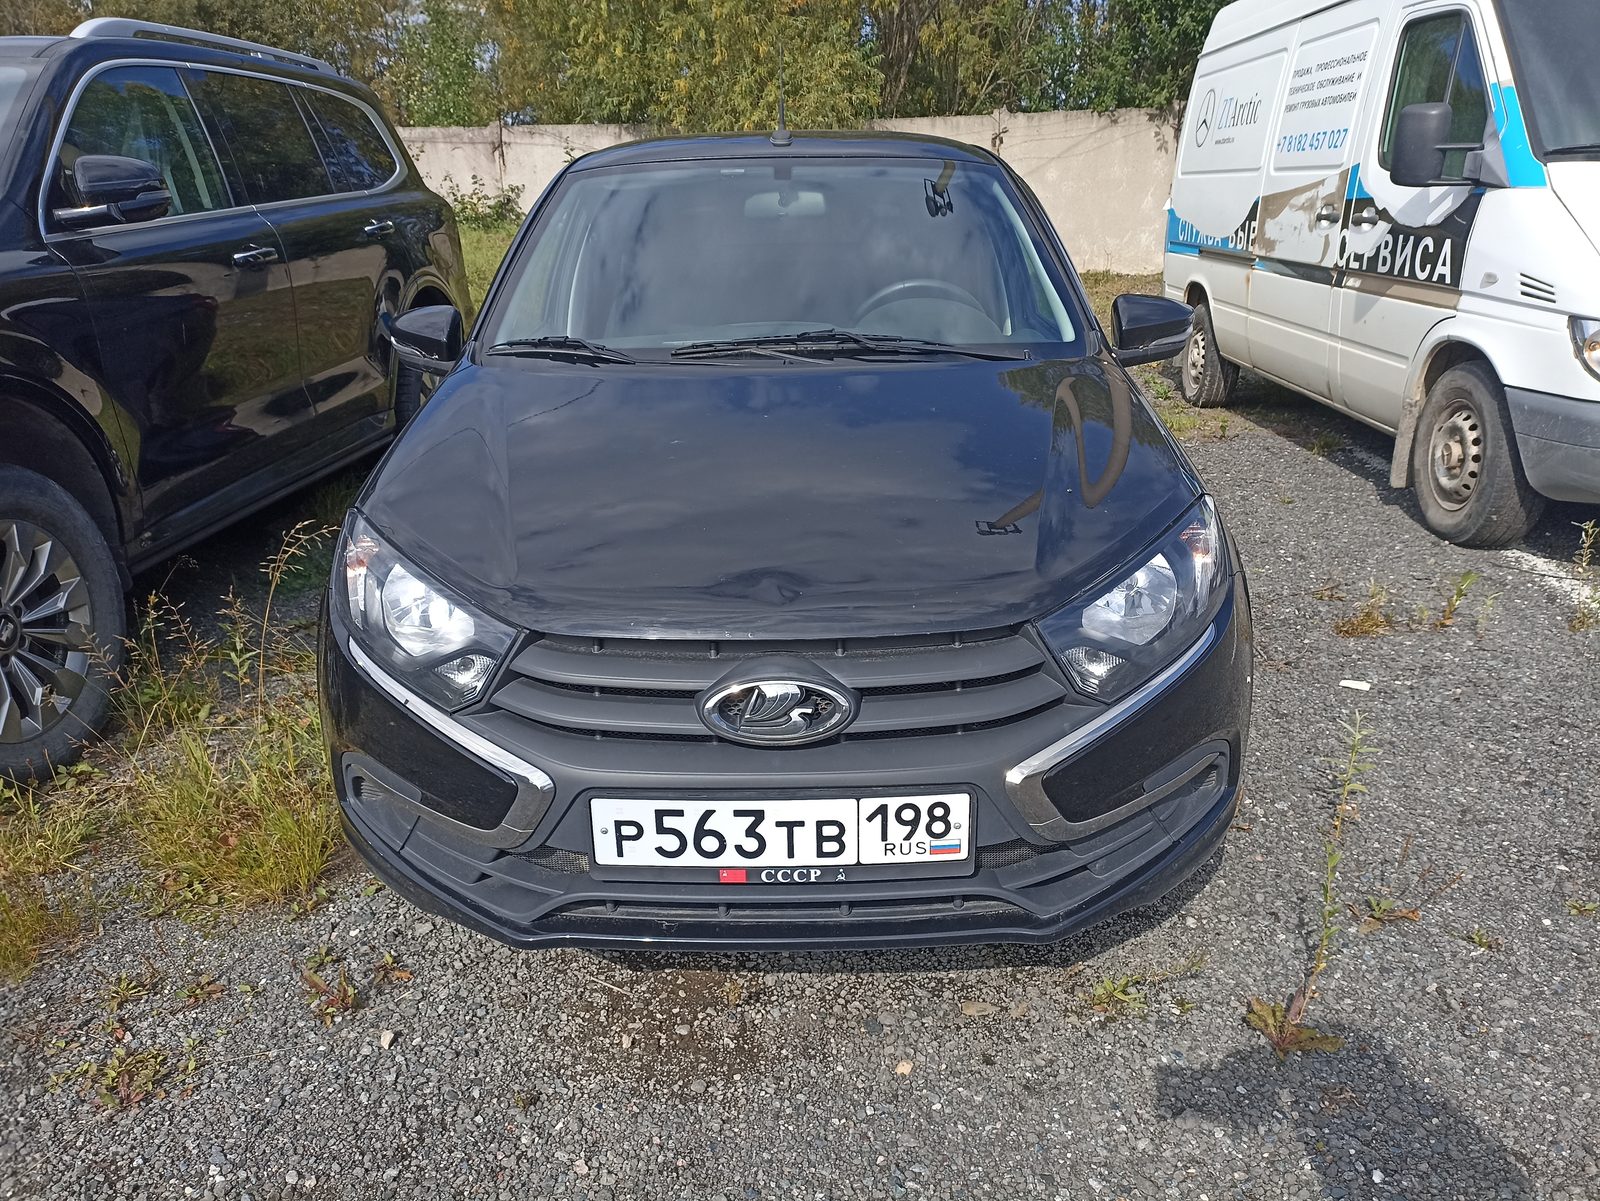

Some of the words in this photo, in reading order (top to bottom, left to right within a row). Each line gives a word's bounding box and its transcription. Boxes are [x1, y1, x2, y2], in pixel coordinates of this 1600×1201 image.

[1287, 133, 1308, 153] 8182
[1309, 131, 1328, 151] 457
[1328, 128, 1349, 149] 027
[865, 801, 952, 843] 198
[884, 841, 927, 856] RUS
[760, 868, 822, 884] СССР
